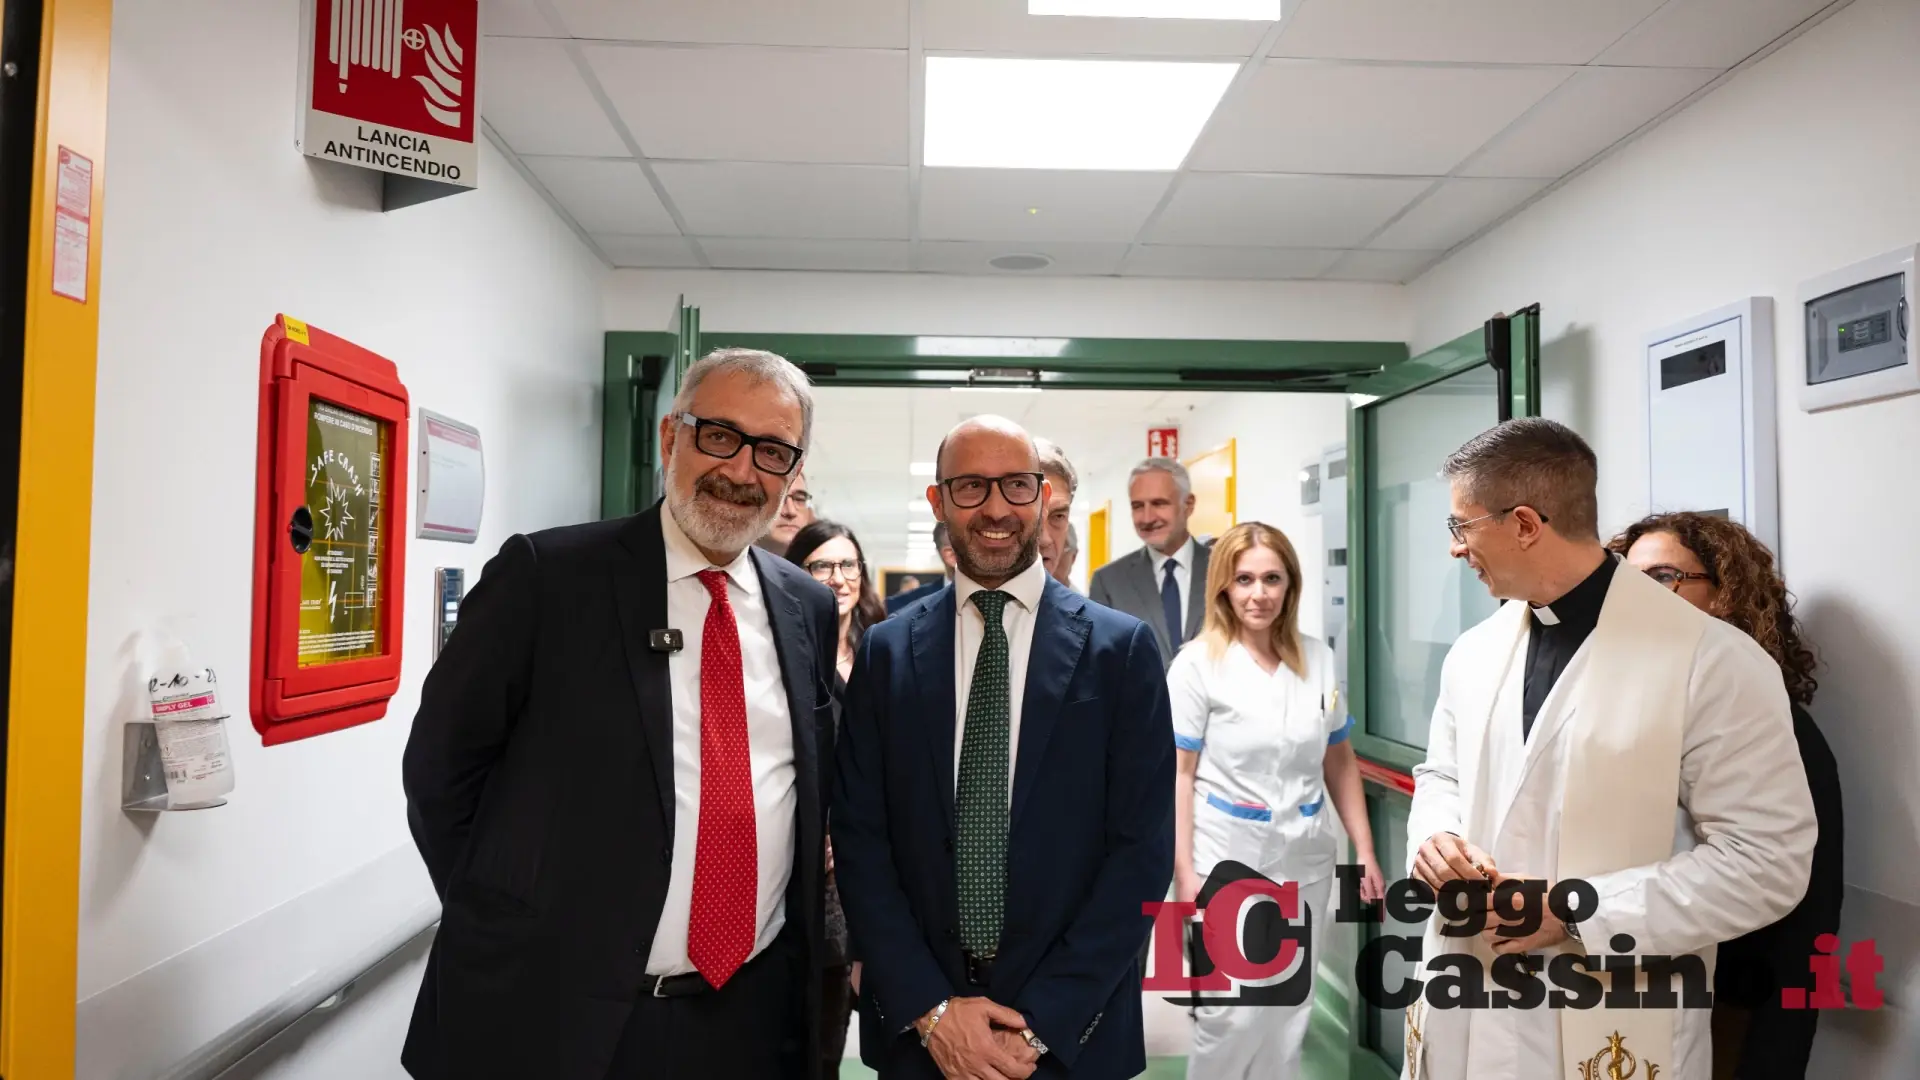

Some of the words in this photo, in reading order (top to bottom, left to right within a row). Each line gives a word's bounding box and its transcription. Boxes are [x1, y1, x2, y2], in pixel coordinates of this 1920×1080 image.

[357, 125, 431, 155] LANCIA
[323, 140, 461, 180] ANTINCENDIO
[310, 449, 335, 488] SAFE
[338, 452, 363, 497] CRASH
[177, 701, 193, 709] GEL
